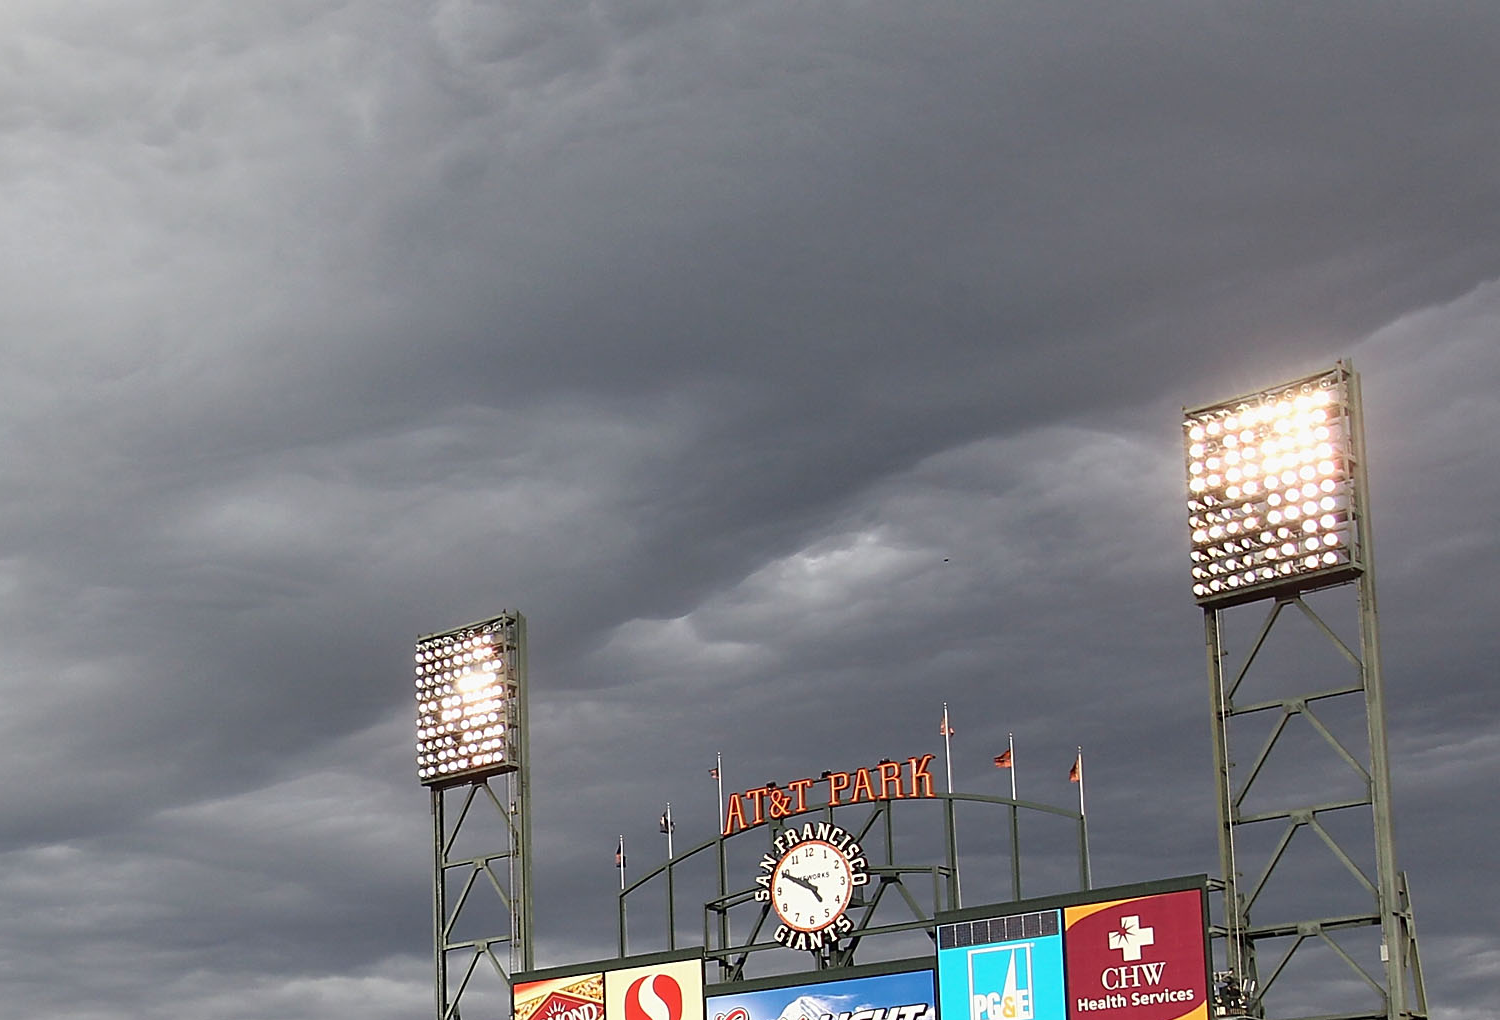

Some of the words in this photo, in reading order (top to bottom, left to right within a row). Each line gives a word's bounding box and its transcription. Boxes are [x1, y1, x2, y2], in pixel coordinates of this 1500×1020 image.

[723, 778, 814, 836] AT&T
[828, 753, 936, 806] PARK
[805, 848, 814, 857] 12
[823, 850, 827, 859] 1
[755, 853, 778, 902] SAN
[774, 822, 868, 886] FRANCISCO
[791, 855, 799, 864] 11
[834, 860, 839, 869] 2
[840, 876, 845, 885] 3
[777, 887, 782, 896] 9
[835, 895, 840, 904] 4
[782, 903, 788, 912] 8
[794, 913, 800, 922] 7
[824, 908, 830, 918] 5
[809, 916, 815, 925] 6
[773, 912, 852, 951] GIANTS
[1101, 962, 1166, 990] CHW
[1077, 992, 1127, 1012] Health
[1132, 988, 1194, 1006] Services
[973, 990, 1029, 1020] PG&E
